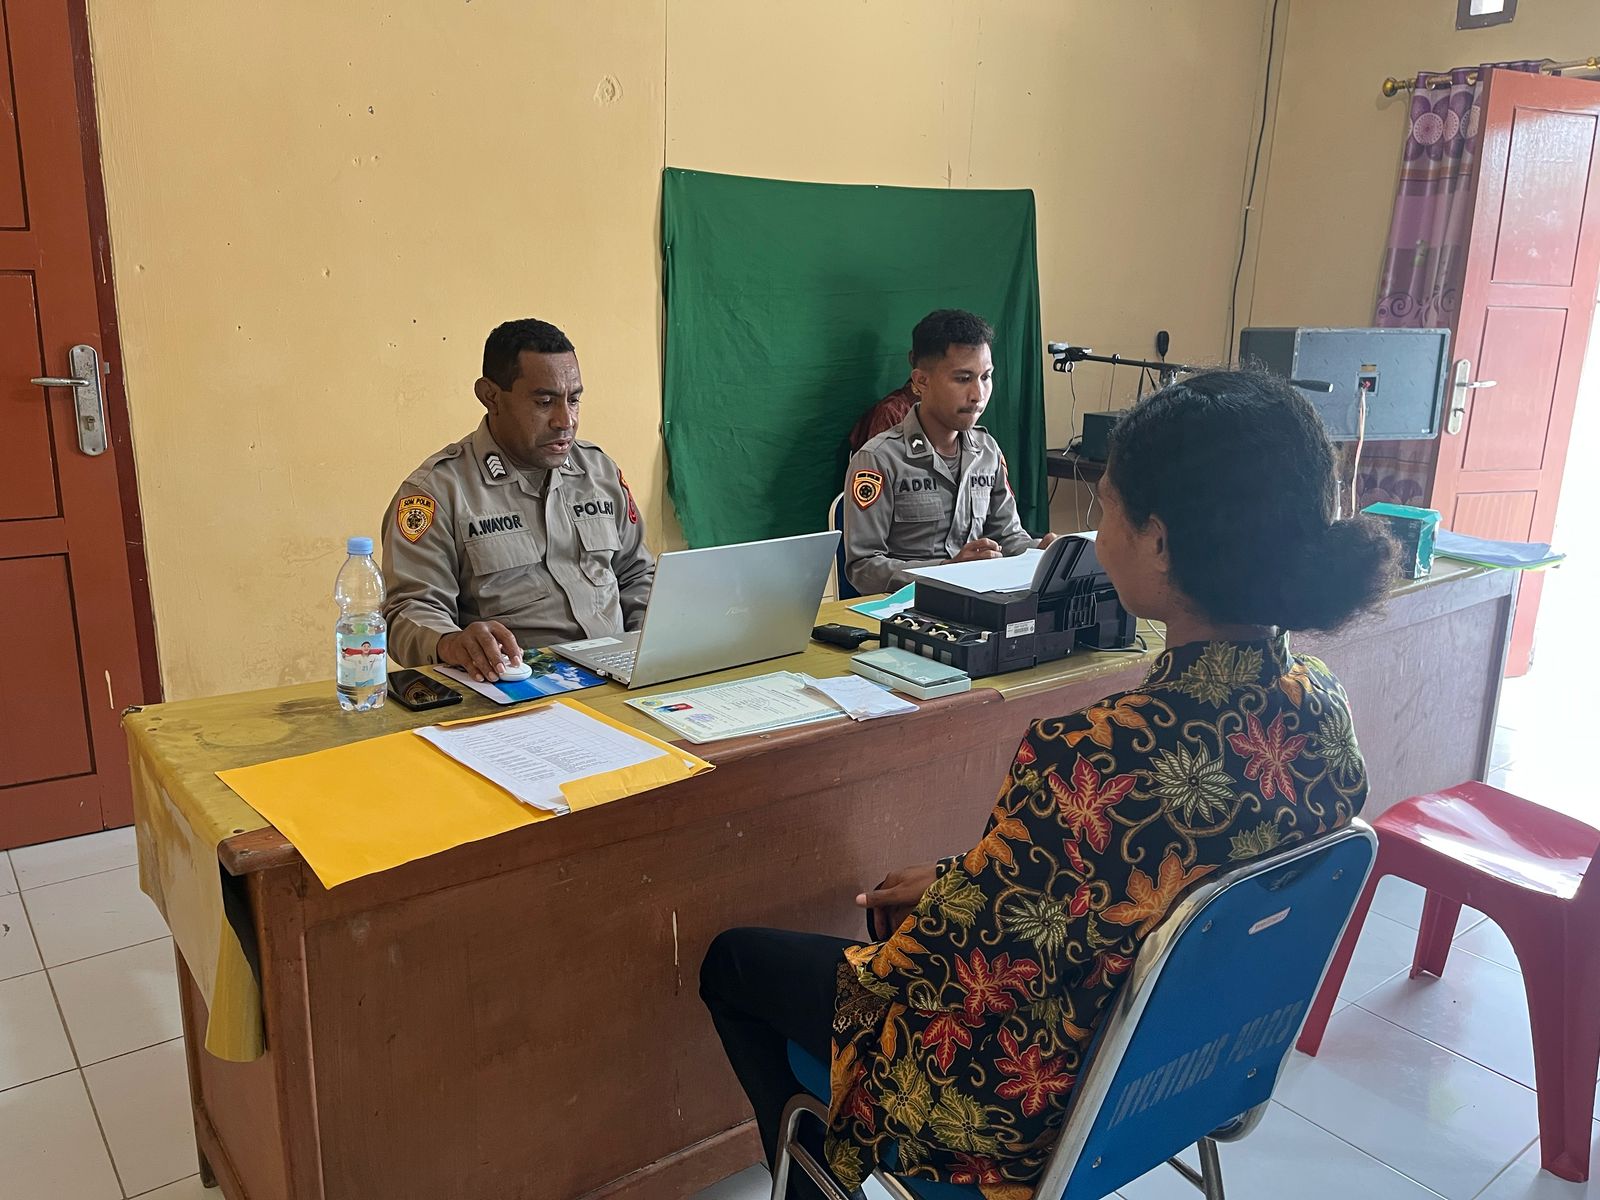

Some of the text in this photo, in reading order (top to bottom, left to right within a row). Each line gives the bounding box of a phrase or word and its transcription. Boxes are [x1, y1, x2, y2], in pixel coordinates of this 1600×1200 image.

[898, 477, 938, 493] ADRI
[573, 500, 614, 518] POLRI
[468, 514, 524, 538] A.WAYOR
